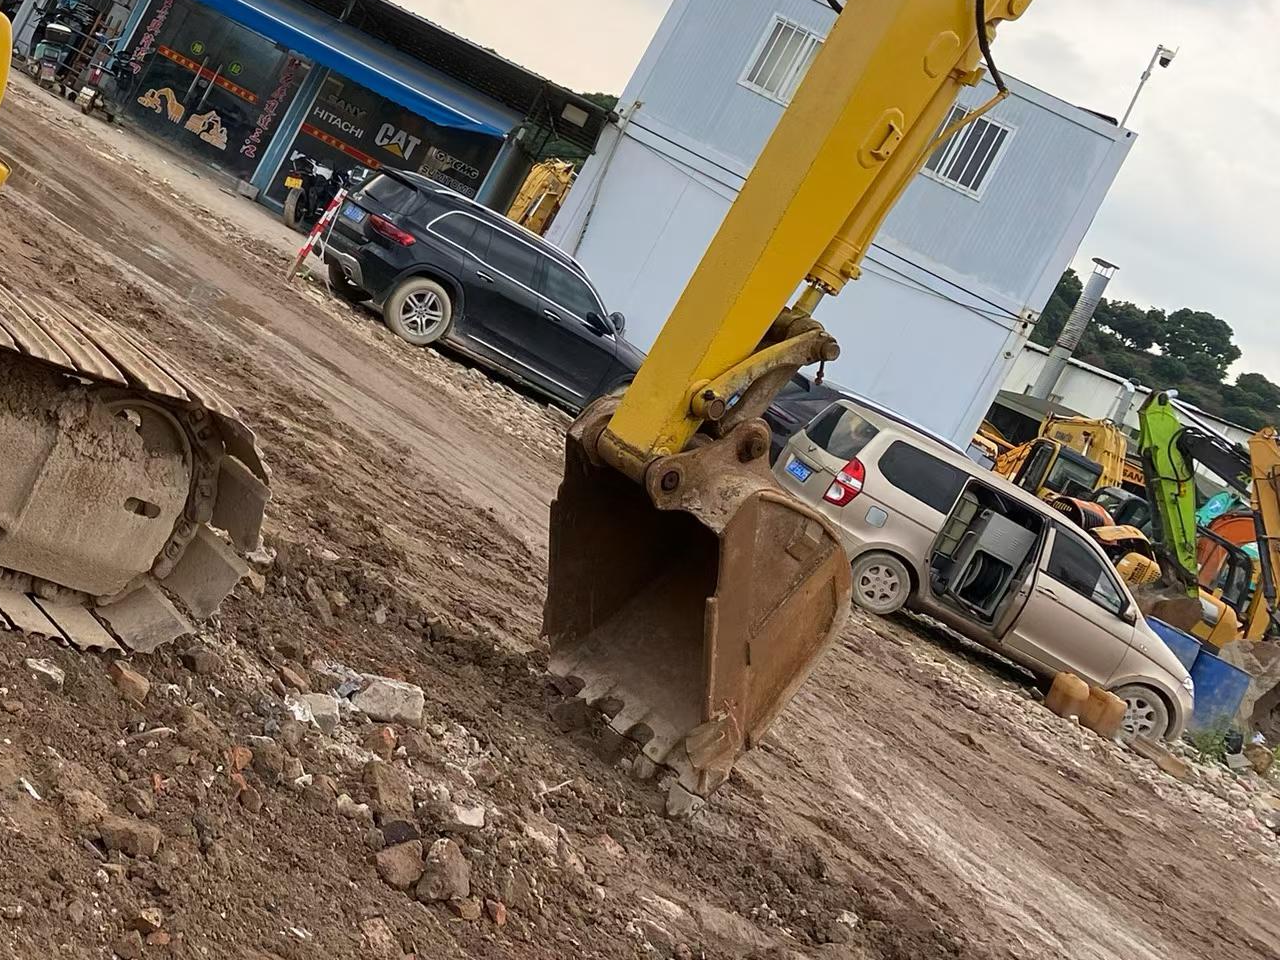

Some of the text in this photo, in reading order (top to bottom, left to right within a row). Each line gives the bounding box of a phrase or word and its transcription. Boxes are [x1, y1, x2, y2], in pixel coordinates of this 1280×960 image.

[328, 93, 367, 119] SANY
[312, 106, 365, 139] HITACHI
[374, 122, 422, 161] CAT
[1122, 470, 1143, 484] SAN
